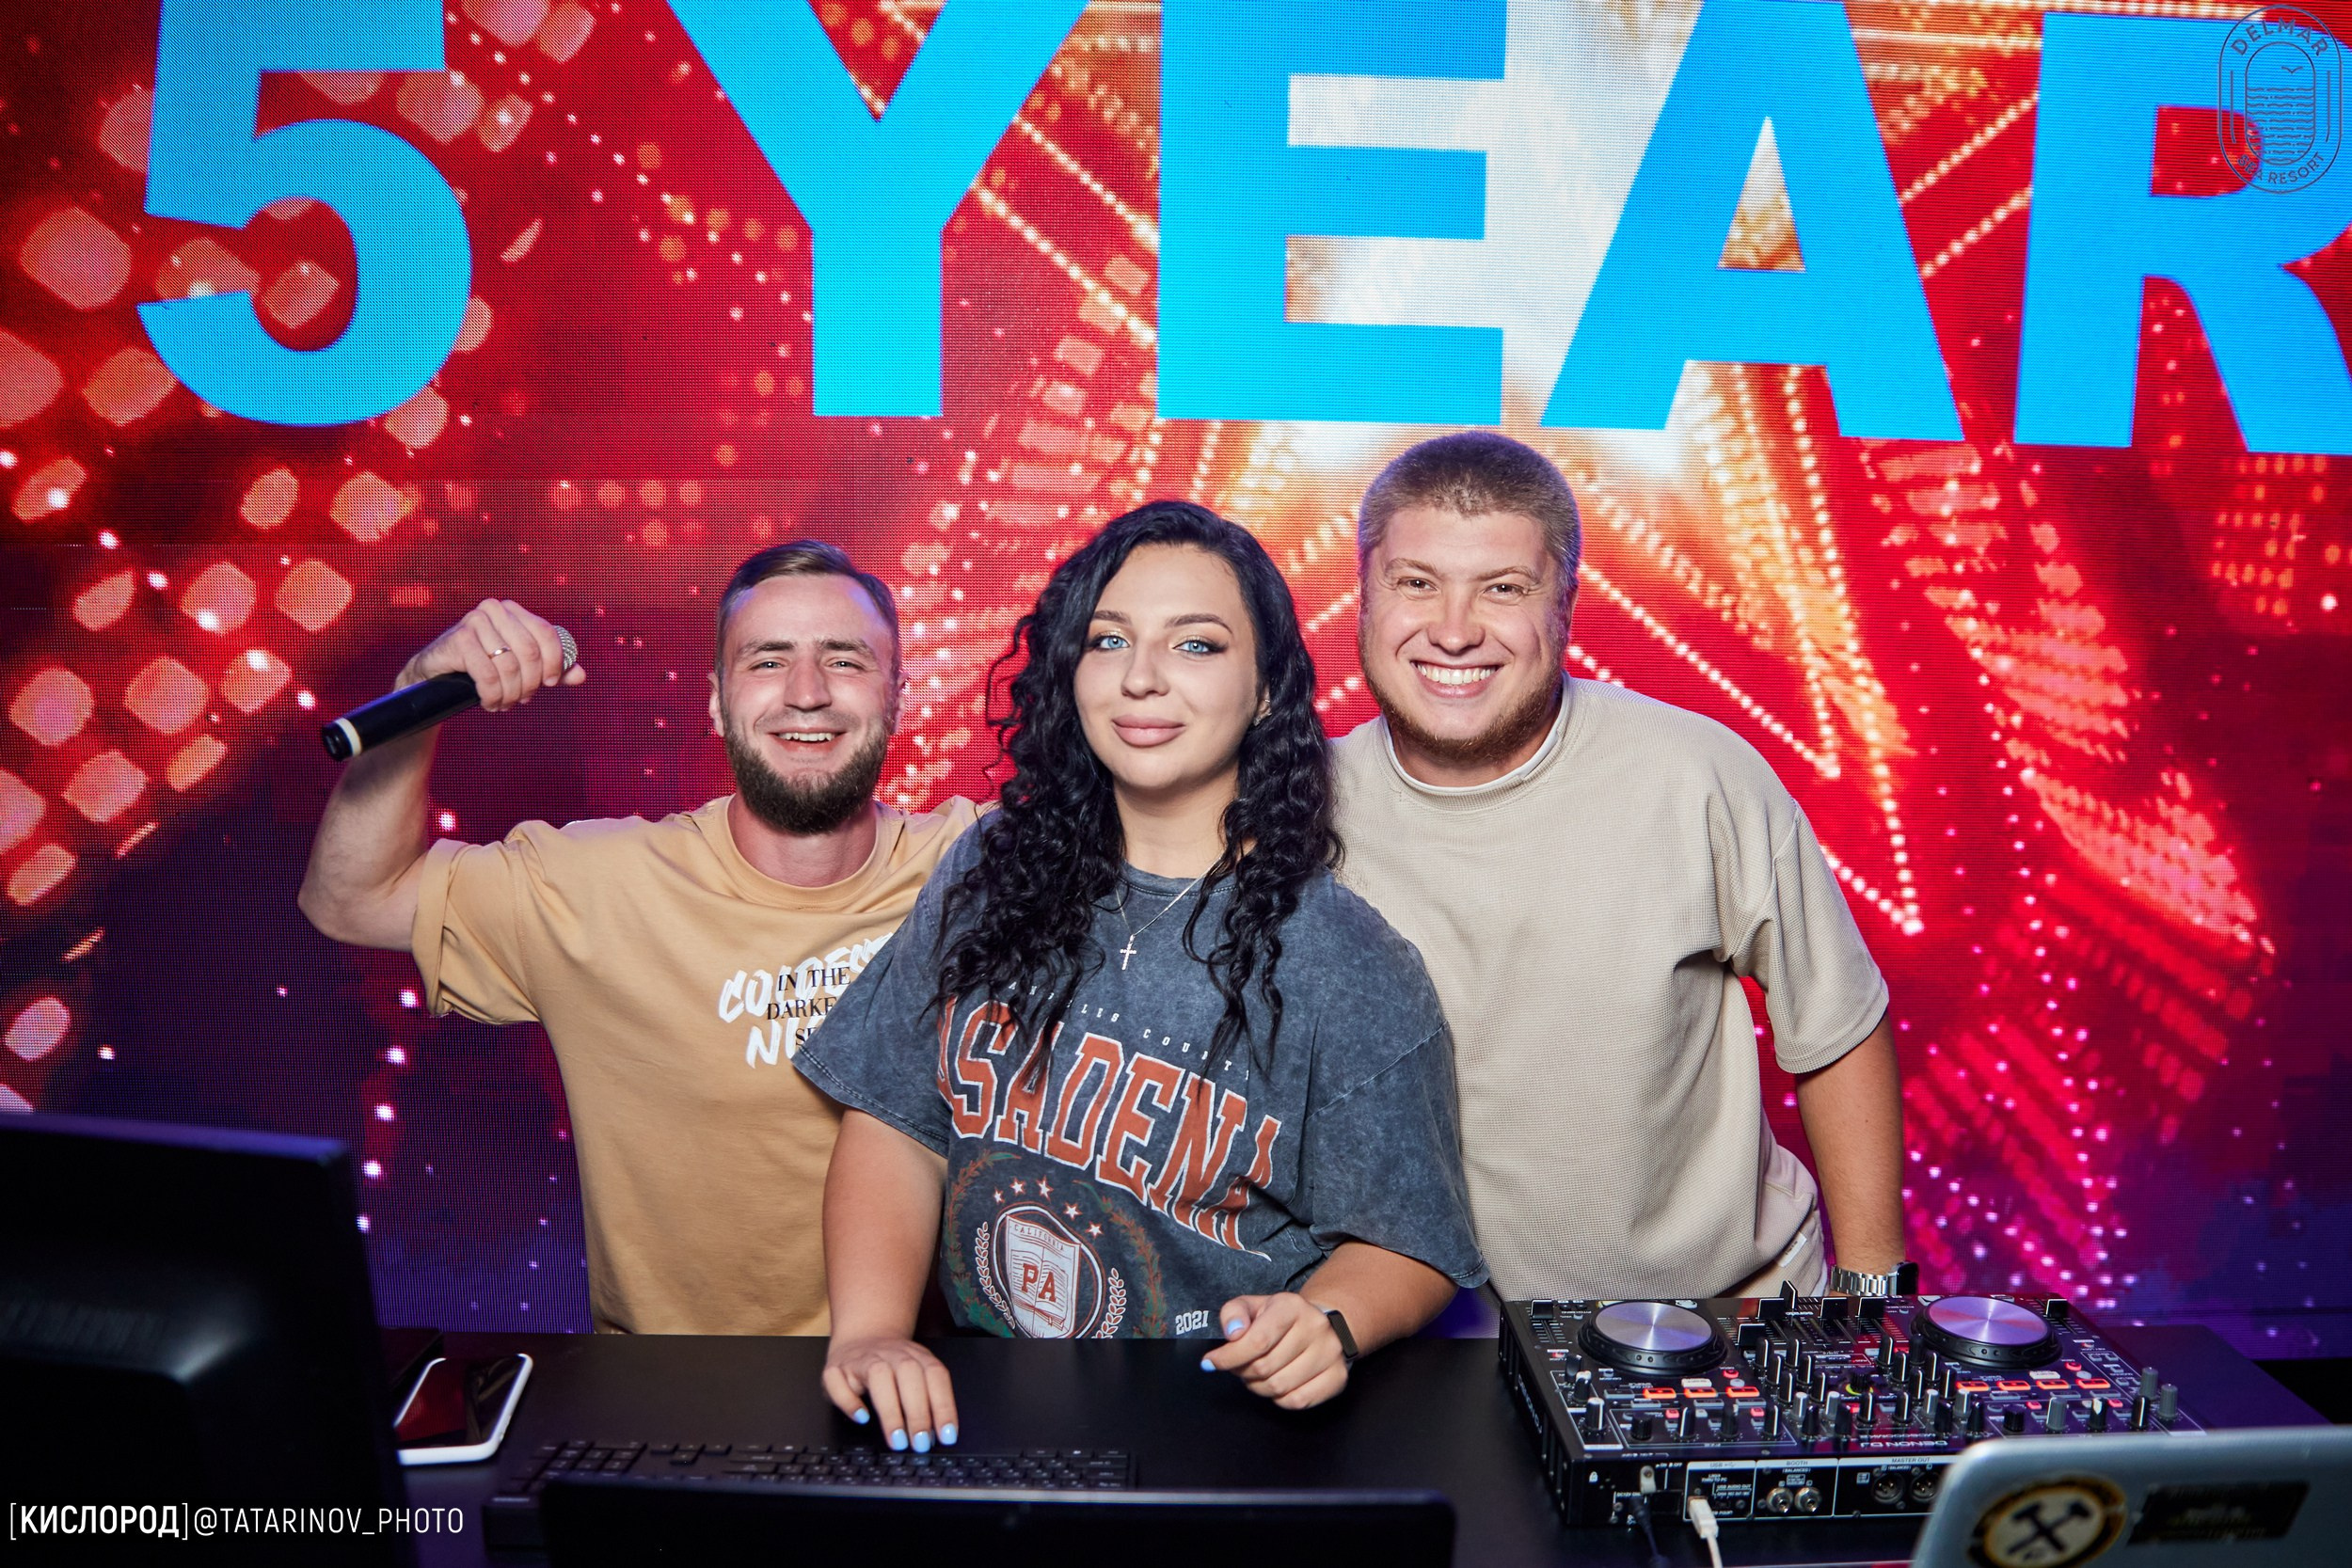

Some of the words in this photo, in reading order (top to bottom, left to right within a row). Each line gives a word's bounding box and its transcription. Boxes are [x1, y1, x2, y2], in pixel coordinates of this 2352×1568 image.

[137, 0, 472, 427] 5
[777, 973, 798, 991] IN
[808, 966, 851, 988] THE
[1014, 1224, 1065, 1251] CALIFORNIA
[1021, 1262, 1057, 1303] PA
[1175, 1310, 1209, 1336] 2021
